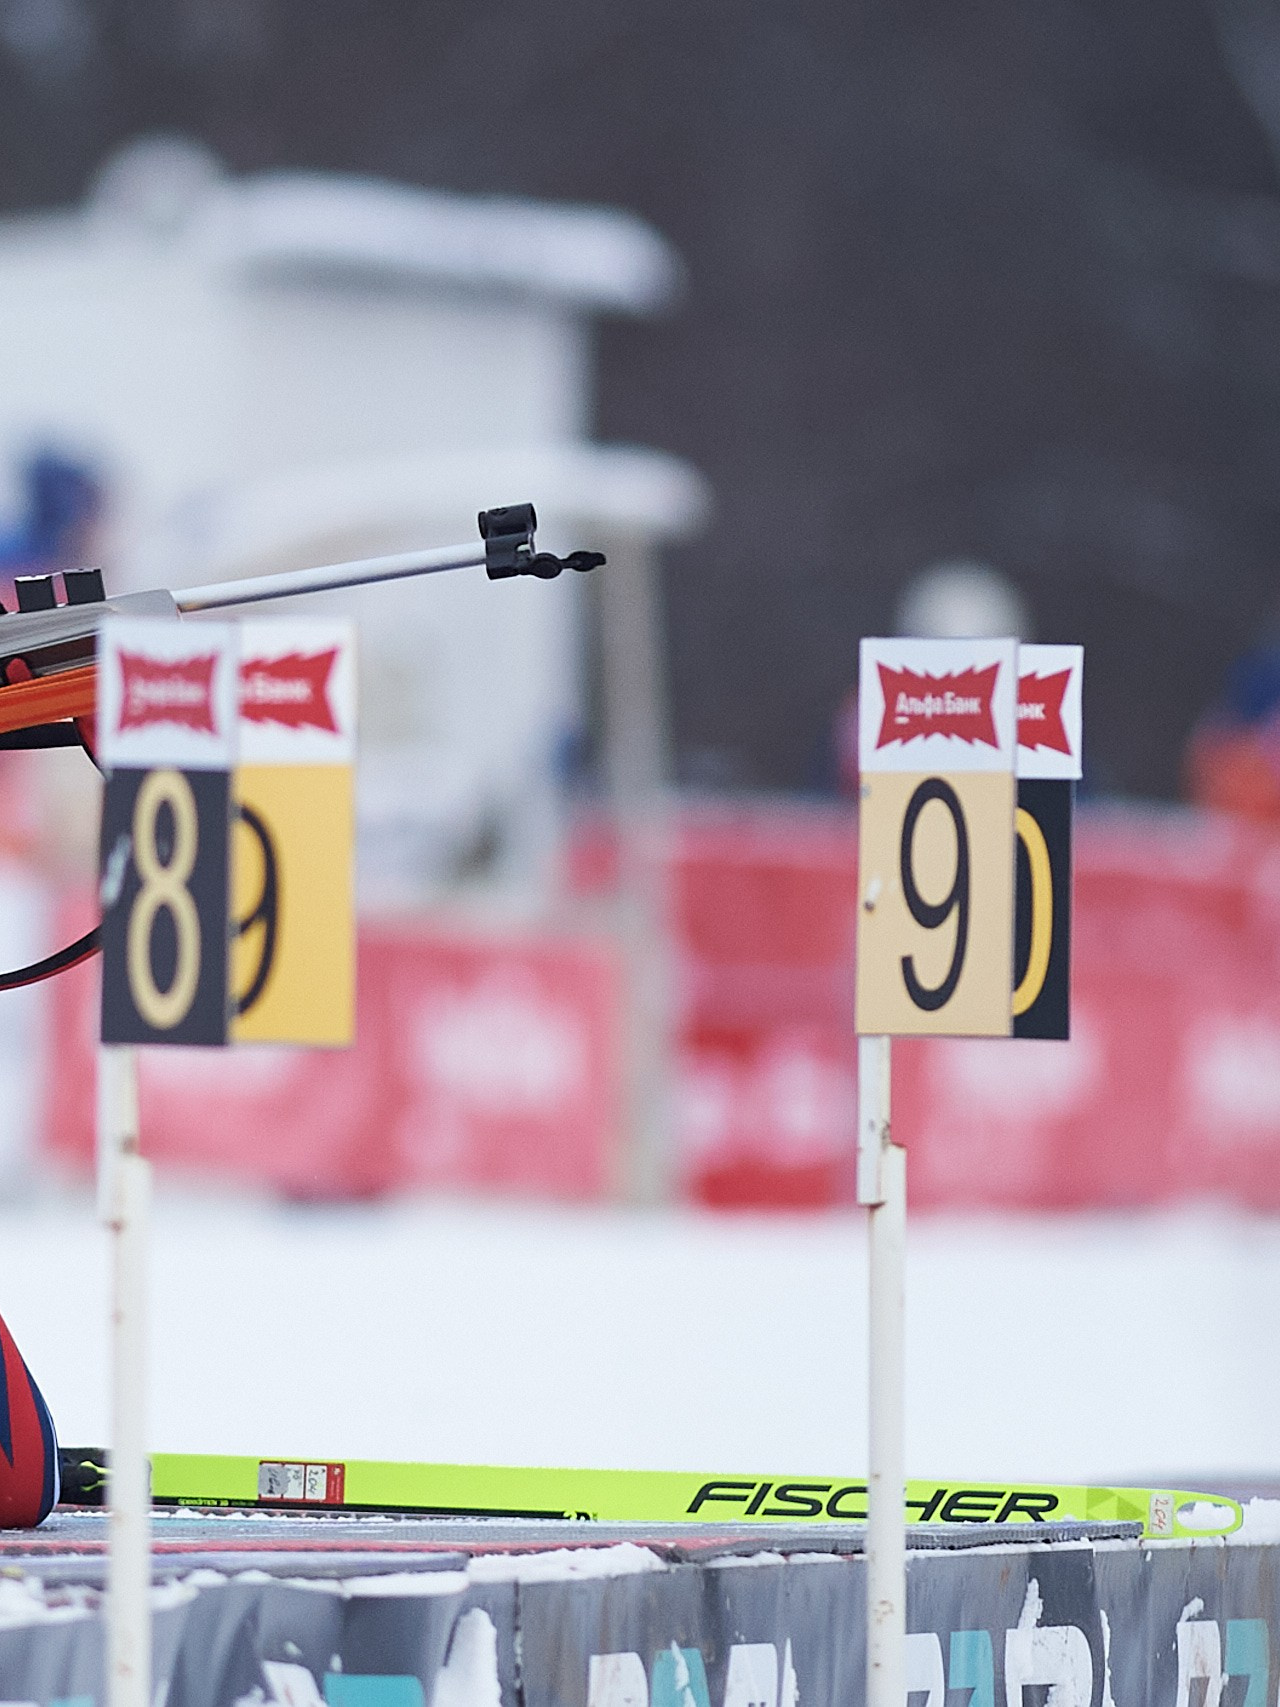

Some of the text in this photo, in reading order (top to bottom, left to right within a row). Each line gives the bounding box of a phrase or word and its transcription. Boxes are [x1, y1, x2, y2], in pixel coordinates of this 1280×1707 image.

[127, 768, 201, 1029] 8
[901, 777, 971, 1012] 9
[687, 1481, 1060, 1524] FISCHER
